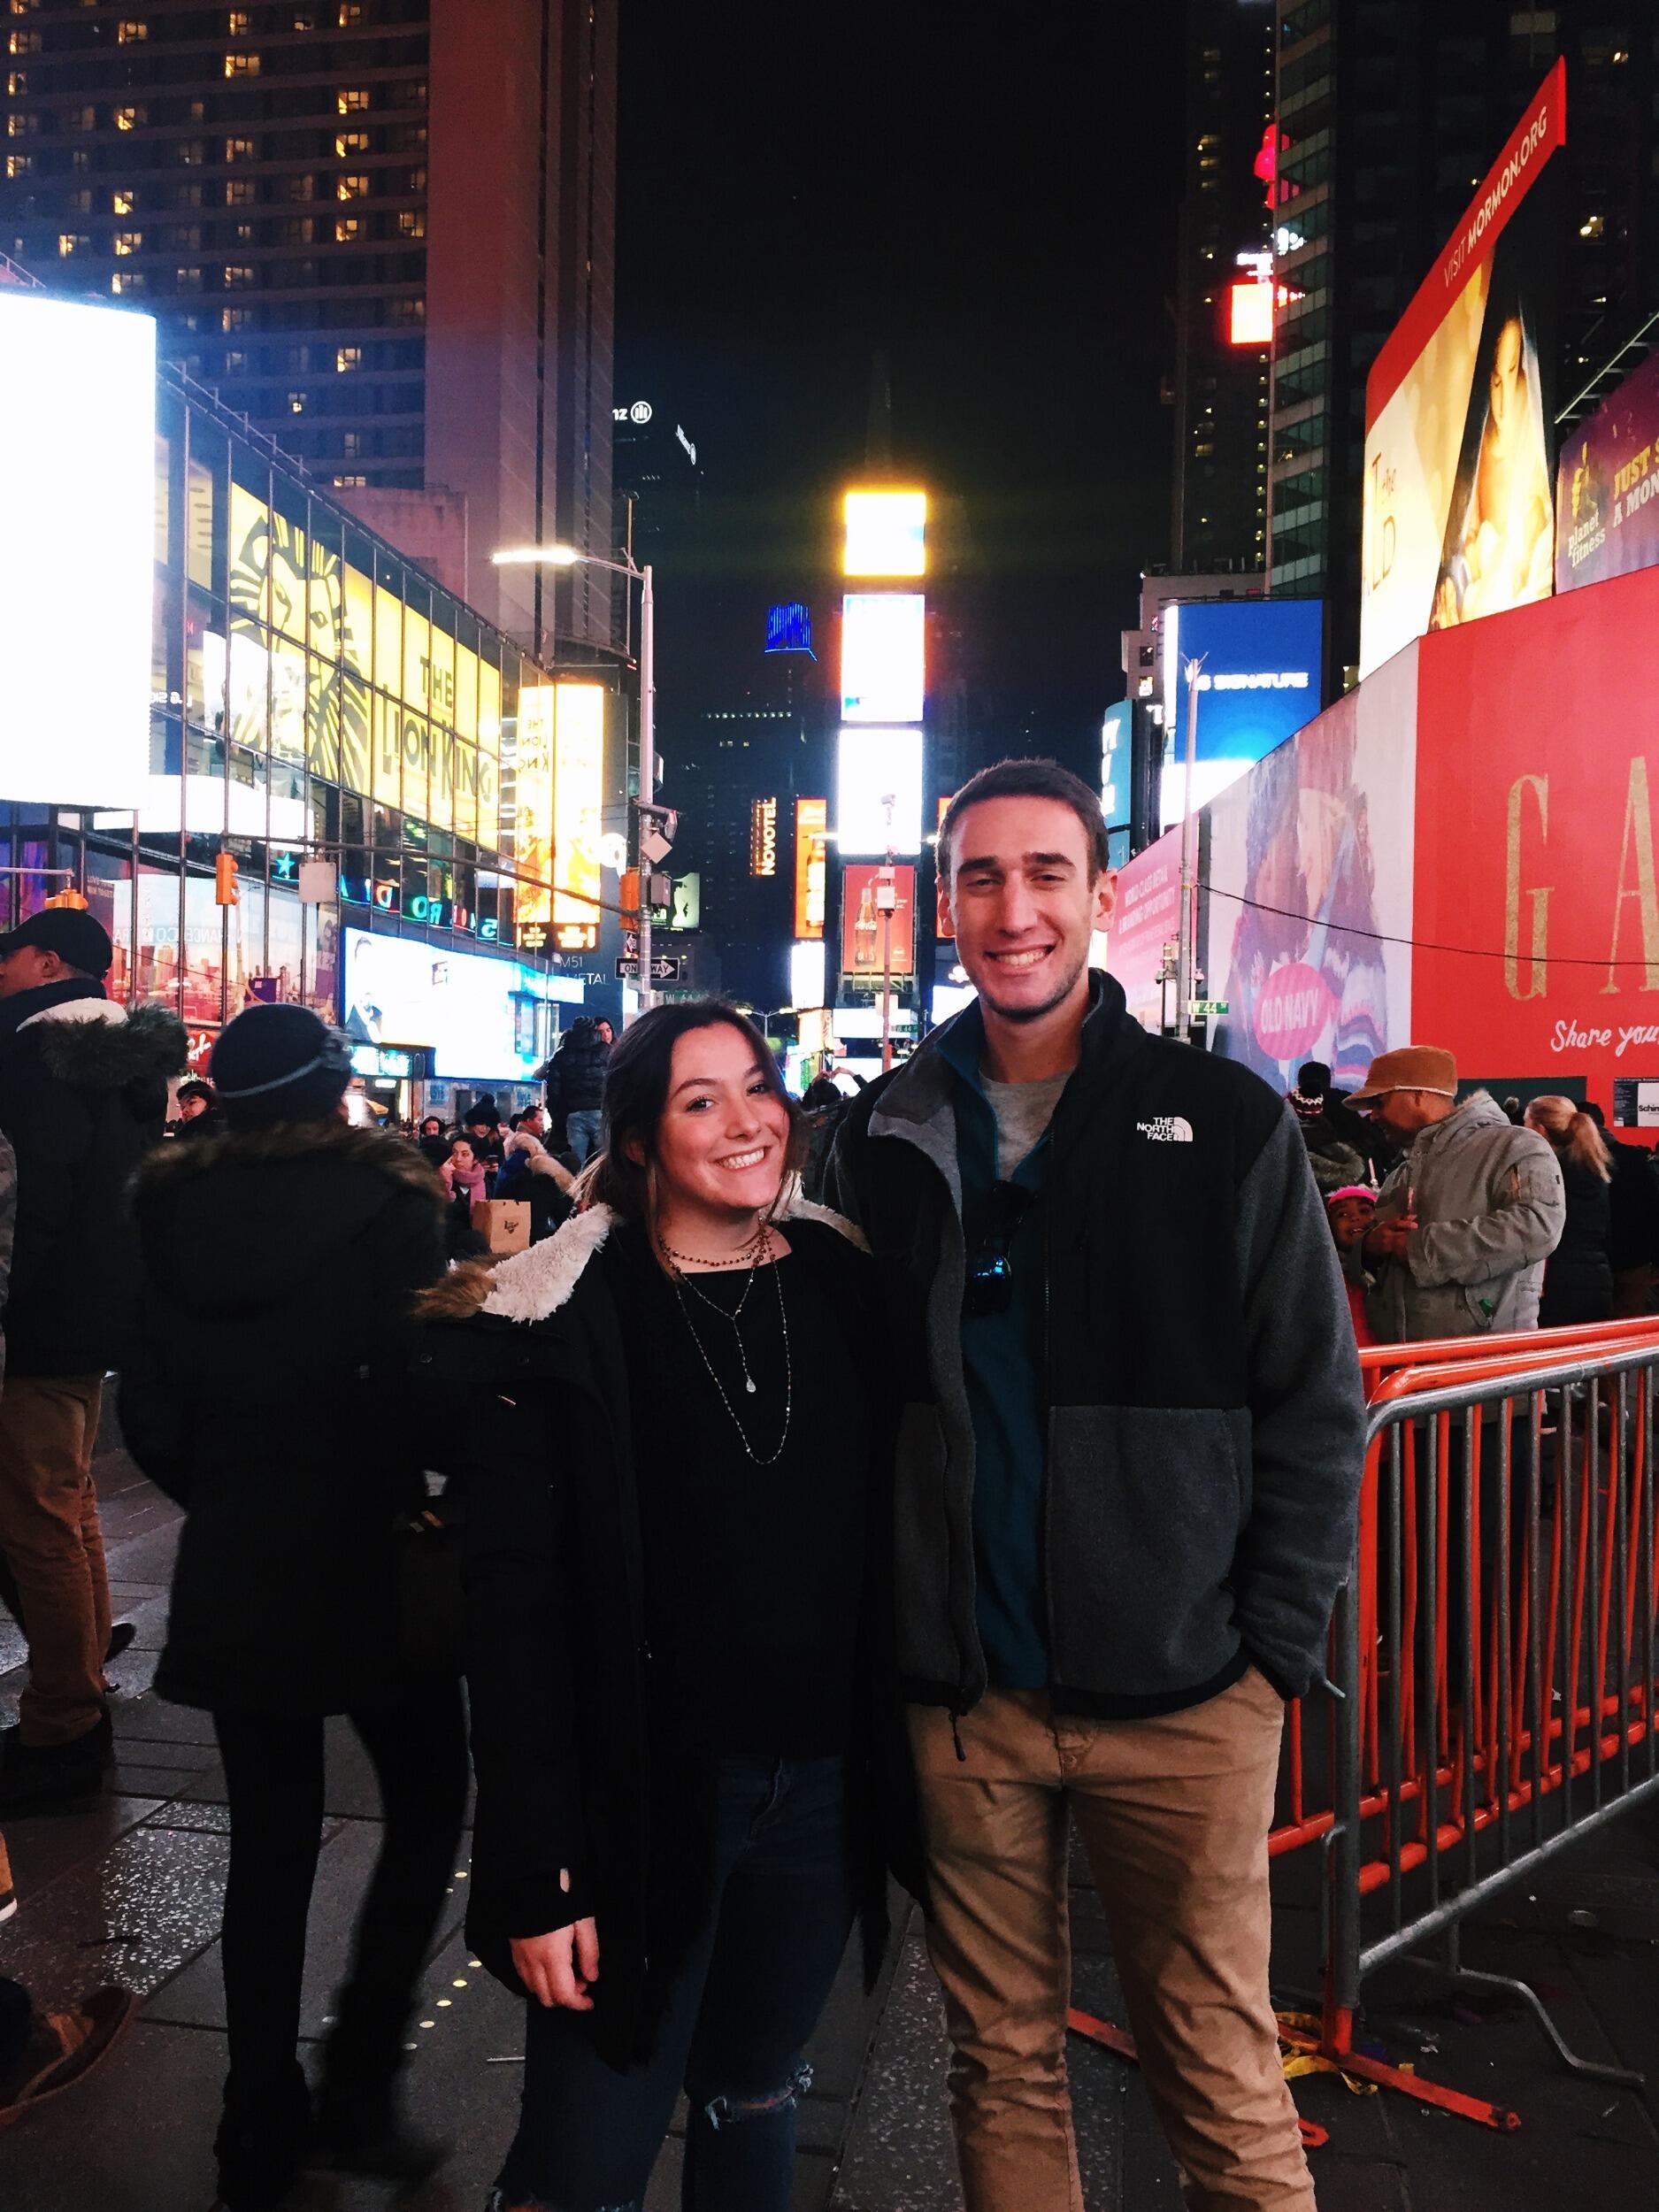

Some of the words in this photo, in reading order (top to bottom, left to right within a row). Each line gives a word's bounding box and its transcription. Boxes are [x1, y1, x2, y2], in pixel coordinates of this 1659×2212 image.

[1443, 237, 1466, 288] VISIT
[1467, 105, 1547, 254] MORMON.ORG
[1613, 445, 1651, 502] JUST
[1568, 508, 1600, 558] planet
[1612, 501, 1623, 529] A
[1571, 527, 1607, 569] fitness
[419, 655, 453, 710] THE
[1213, 672, 1310, 691] SIGNATURE
[382, 683, 438, 778] LION
[442, 717, 493, 803] KING
[761, 796, 778, 876] NOVOTEL
[1504, 756, 1659, 1001] GA
[650, 964, 670, 973] WAY
[1192, 1002, 1200, 1014] W
[1203, 1002, 1217, 1014] 44
[1261, 996, 1283, 1034] OLD
[1284, 987, 1319, 1032] NAVY
[1550, 1019, 1612, 1052] Share
[1615, 1025, 1659, 1057] you
[1136, 1122, 1174, 1133] NORTH
[1147, 1132, 1173, 1141] FACE
[1152, 1117, 1174, 1125] THE
